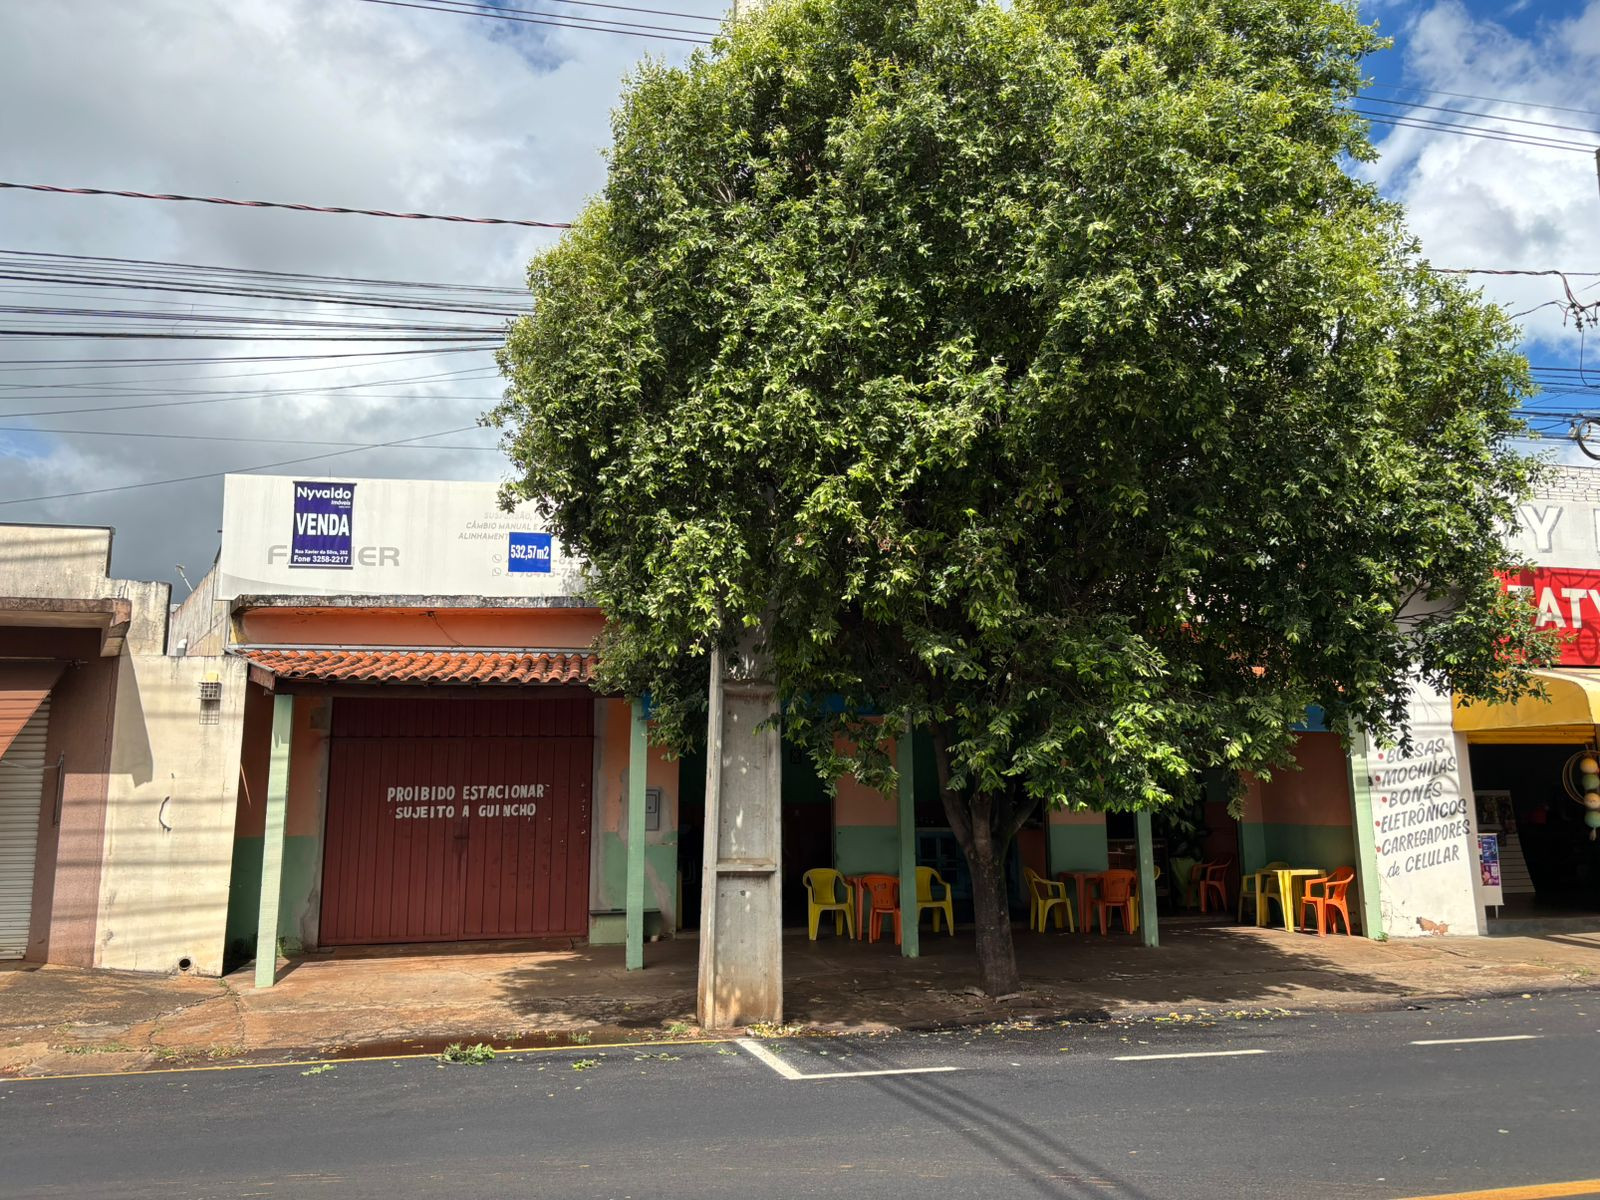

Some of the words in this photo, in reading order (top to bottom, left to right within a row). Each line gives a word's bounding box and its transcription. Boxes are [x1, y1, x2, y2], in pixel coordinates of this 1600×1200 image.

[297, 487, 351, 501] Nyvaldo
[296, 512, 350, 536] VENDA
[466, 520, 496, 529] CÂMBIO
[498, 522, 531, 530] MANUAL
[312, 555, 348, 563] 3258-2217
[511, 545, 549, 560] 532,57m2
[1386, 738, 1445, 764] BOSAS
[1382, 757, 1456, 787] MOCHILAS
[387, 786, 456, 802] PROIBIDO
[463, 784, 545, 800] ESTACIONAR
[1389, 778, 1442, 808] BONÉS
[395, 806, 455, 819] SUJEITO
[462, 805, 470, 818] A
[478, 803, 536, 817] GUINCHO
[1381, 798, 1467, 833] ELETRÔNICOS
[1381, 819, 1470, 856] CARREGADORES
[1387, 860, 1400, 878] de
[1405, 844, 1460, 872] CELULAR
